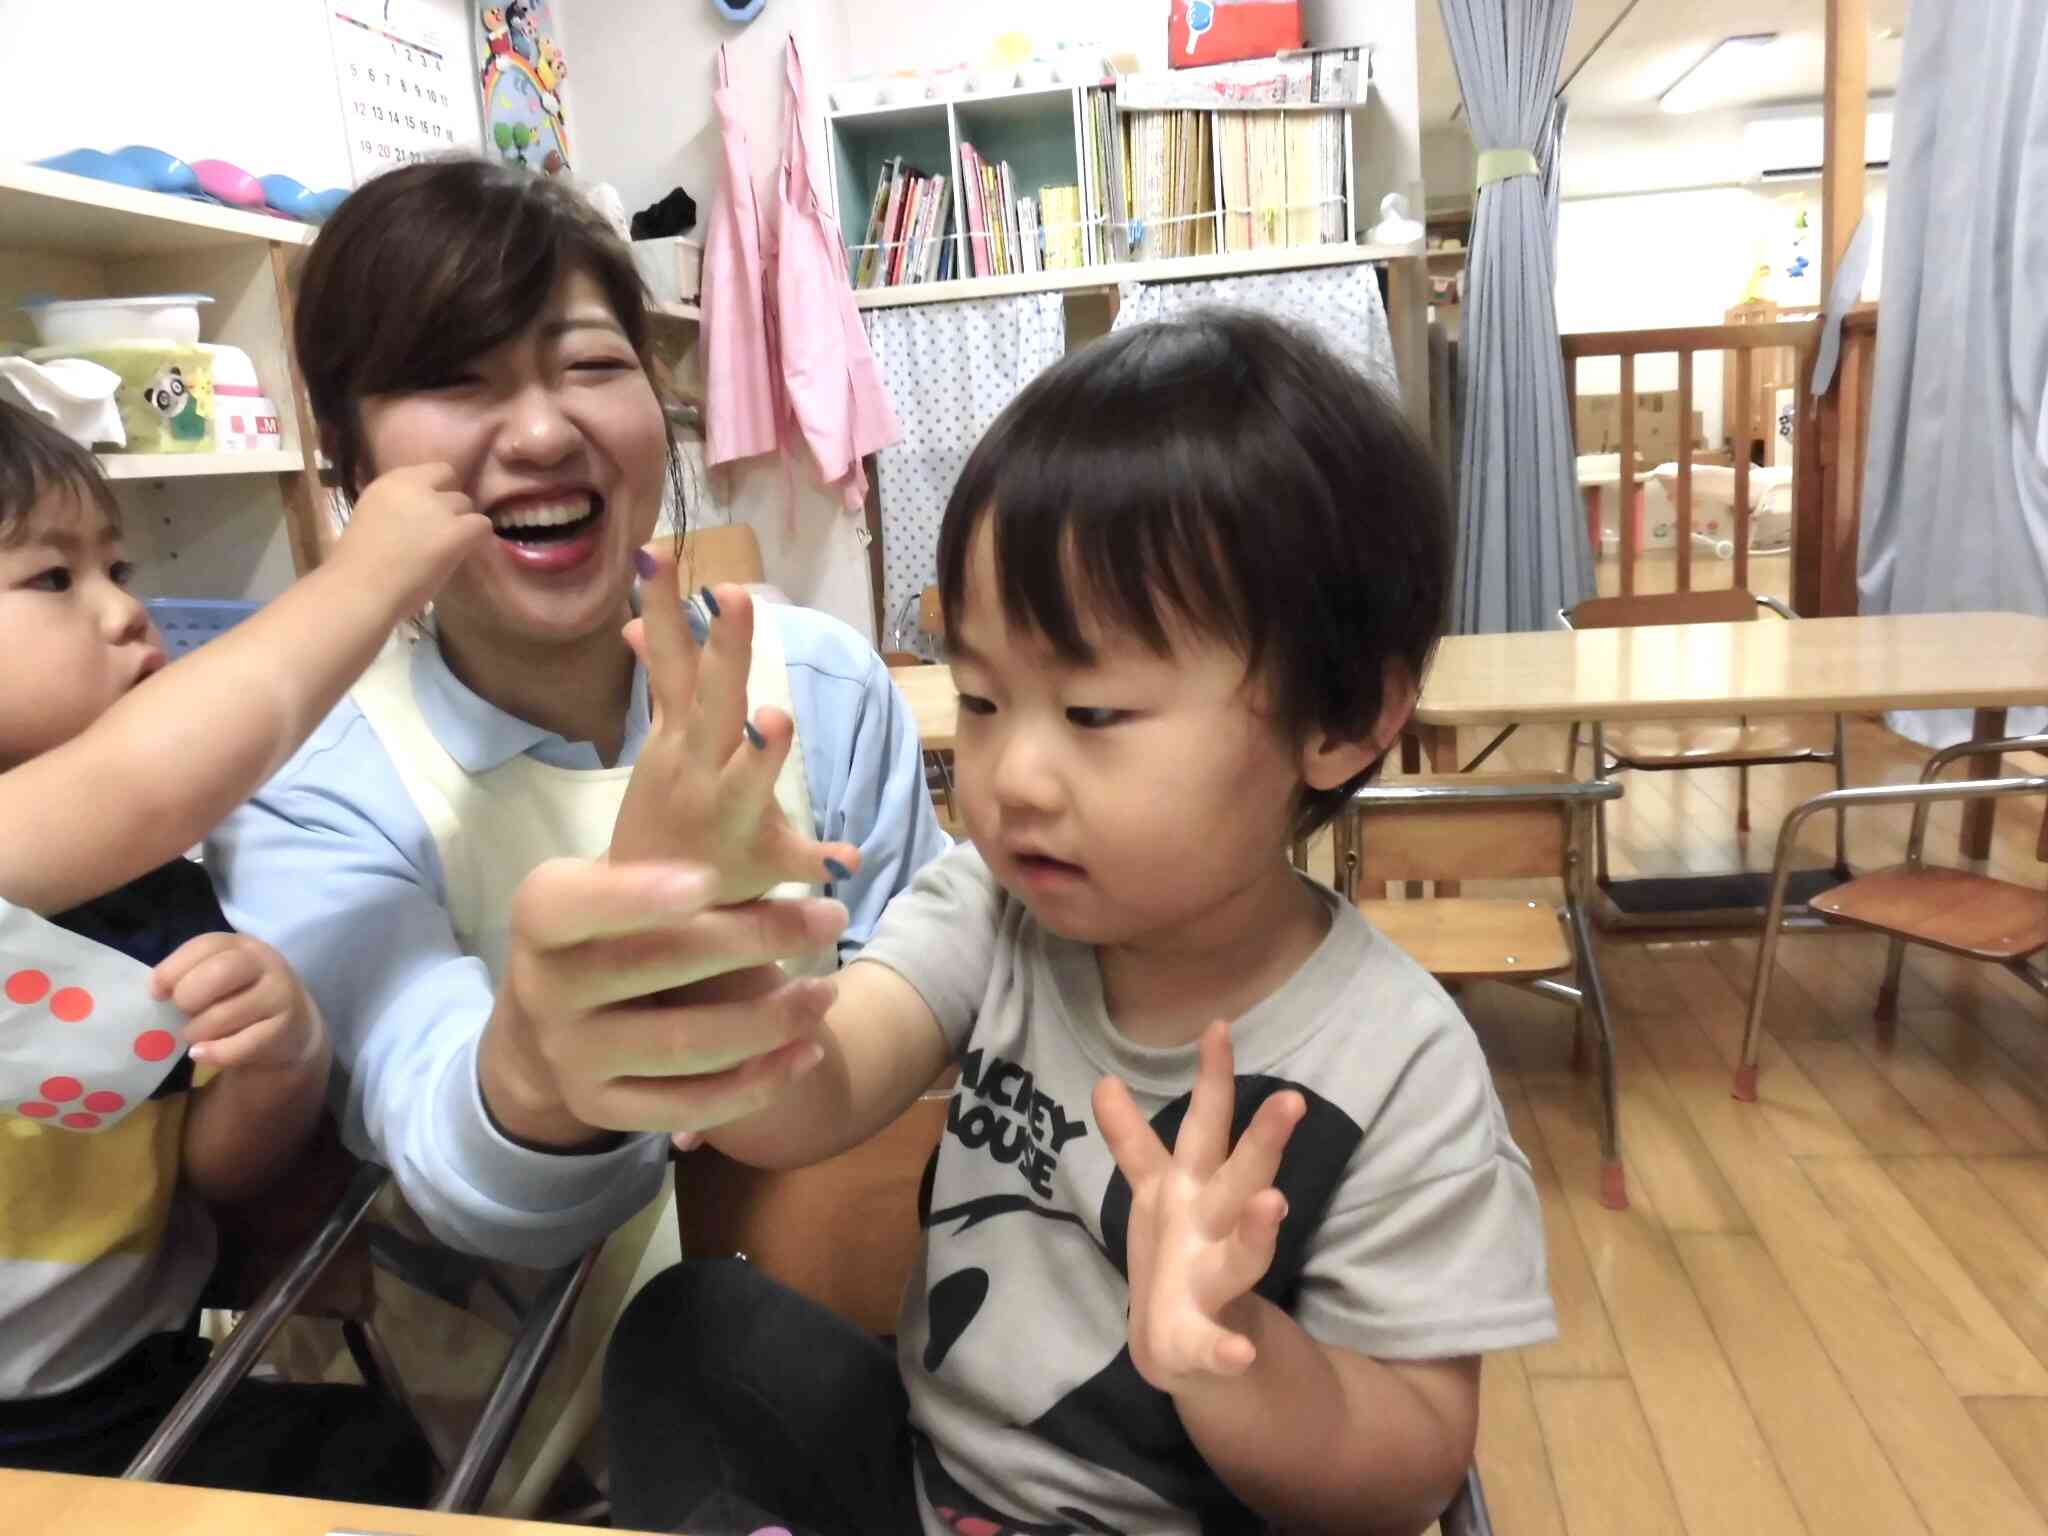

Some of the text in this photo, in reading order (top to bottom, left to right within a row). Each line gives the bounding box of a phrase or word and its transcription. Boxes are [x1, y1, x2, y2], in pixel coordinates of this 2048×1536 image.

[405, 48, 413, 62] 2
[420, 54, 428, 68] 3
[350, 63, 358, 78] 5
[367, 67, 376, 83] 6
[426, 88, 437, 104] 10
[353, 101, 367, 116] 12
[371, 105, 384, 121] 13
[388, 111, 400, 125] 14
[404, 115, 416, 130] 15
[432, 124, 441, 137] 17
[360, 140, 373, 154] 19
[377, 143, 391, 159] 20
[394, 147, 406, 162] 21
